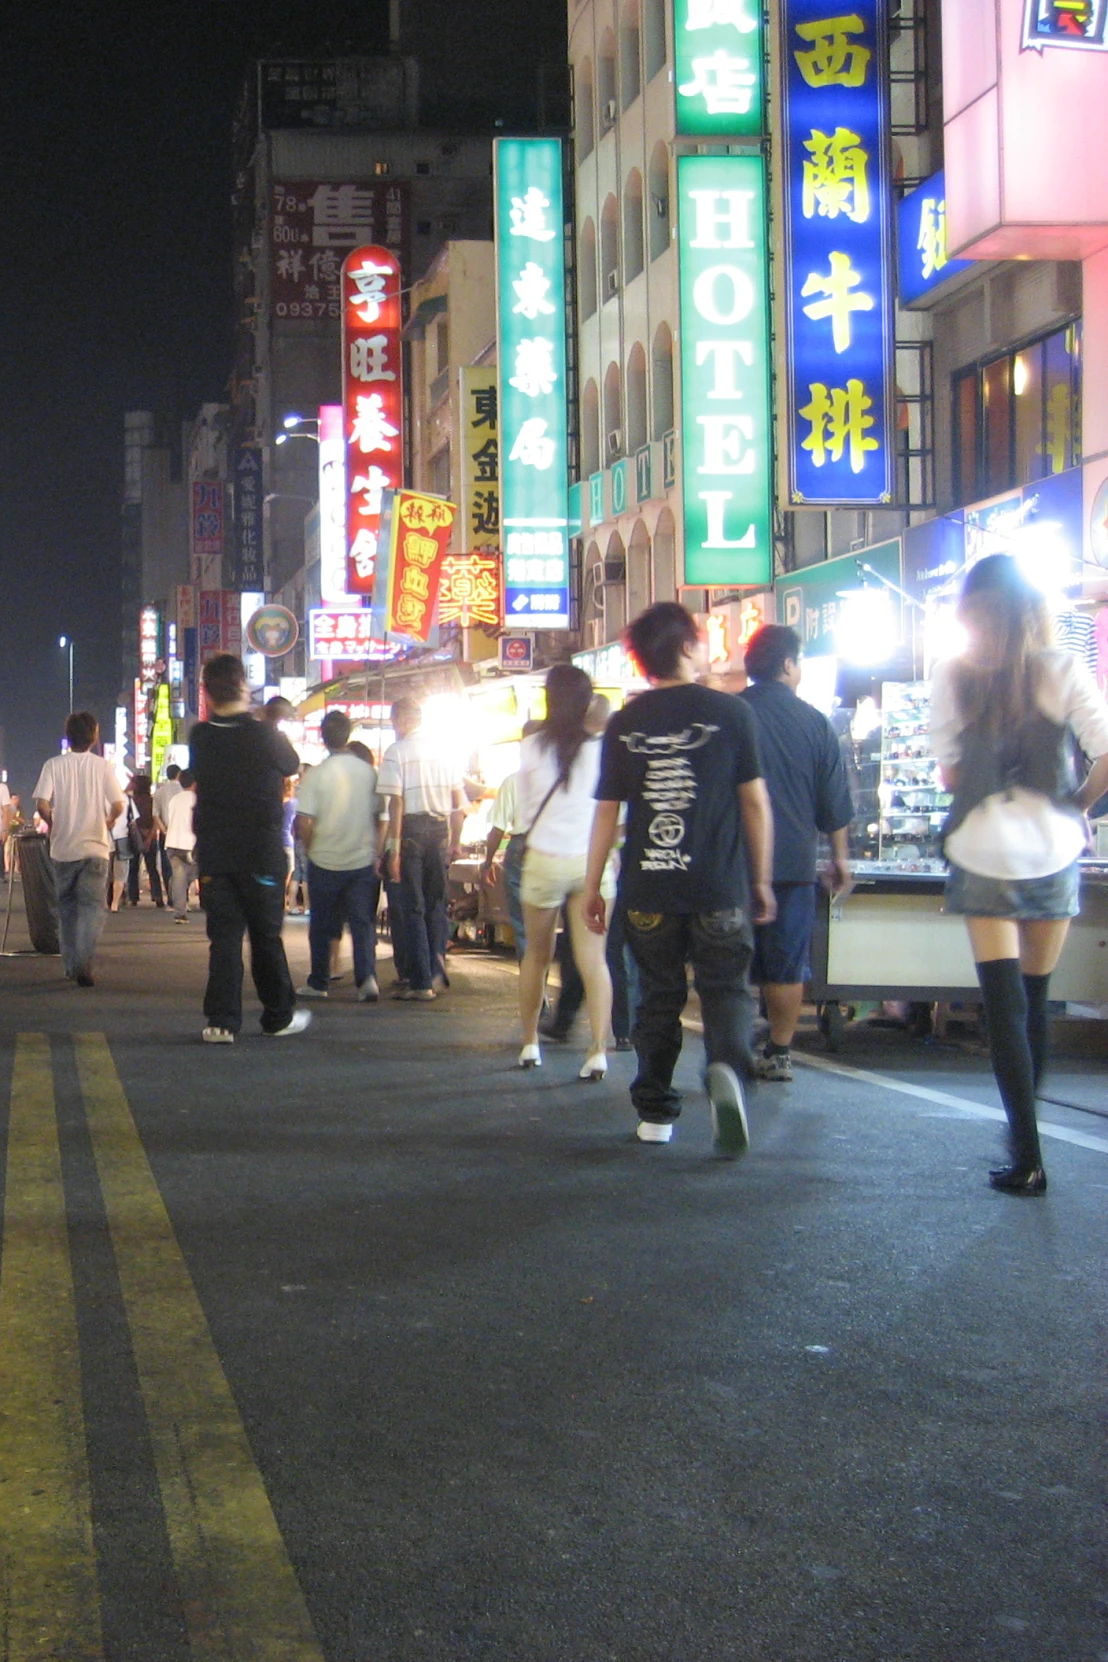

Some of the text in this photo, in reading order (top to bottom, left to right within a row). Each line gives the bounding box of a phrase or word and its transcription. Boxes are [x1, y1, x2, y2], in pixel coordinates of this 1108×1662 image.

[275, 302, 341, 317] 09375
[307, 184, 375, 246] 售
[508, 186, 558, 471] 遠東藥局
[793, 14, 879, 474] 西蘭牛排
[688, 190, 756, 549] HOTEL
